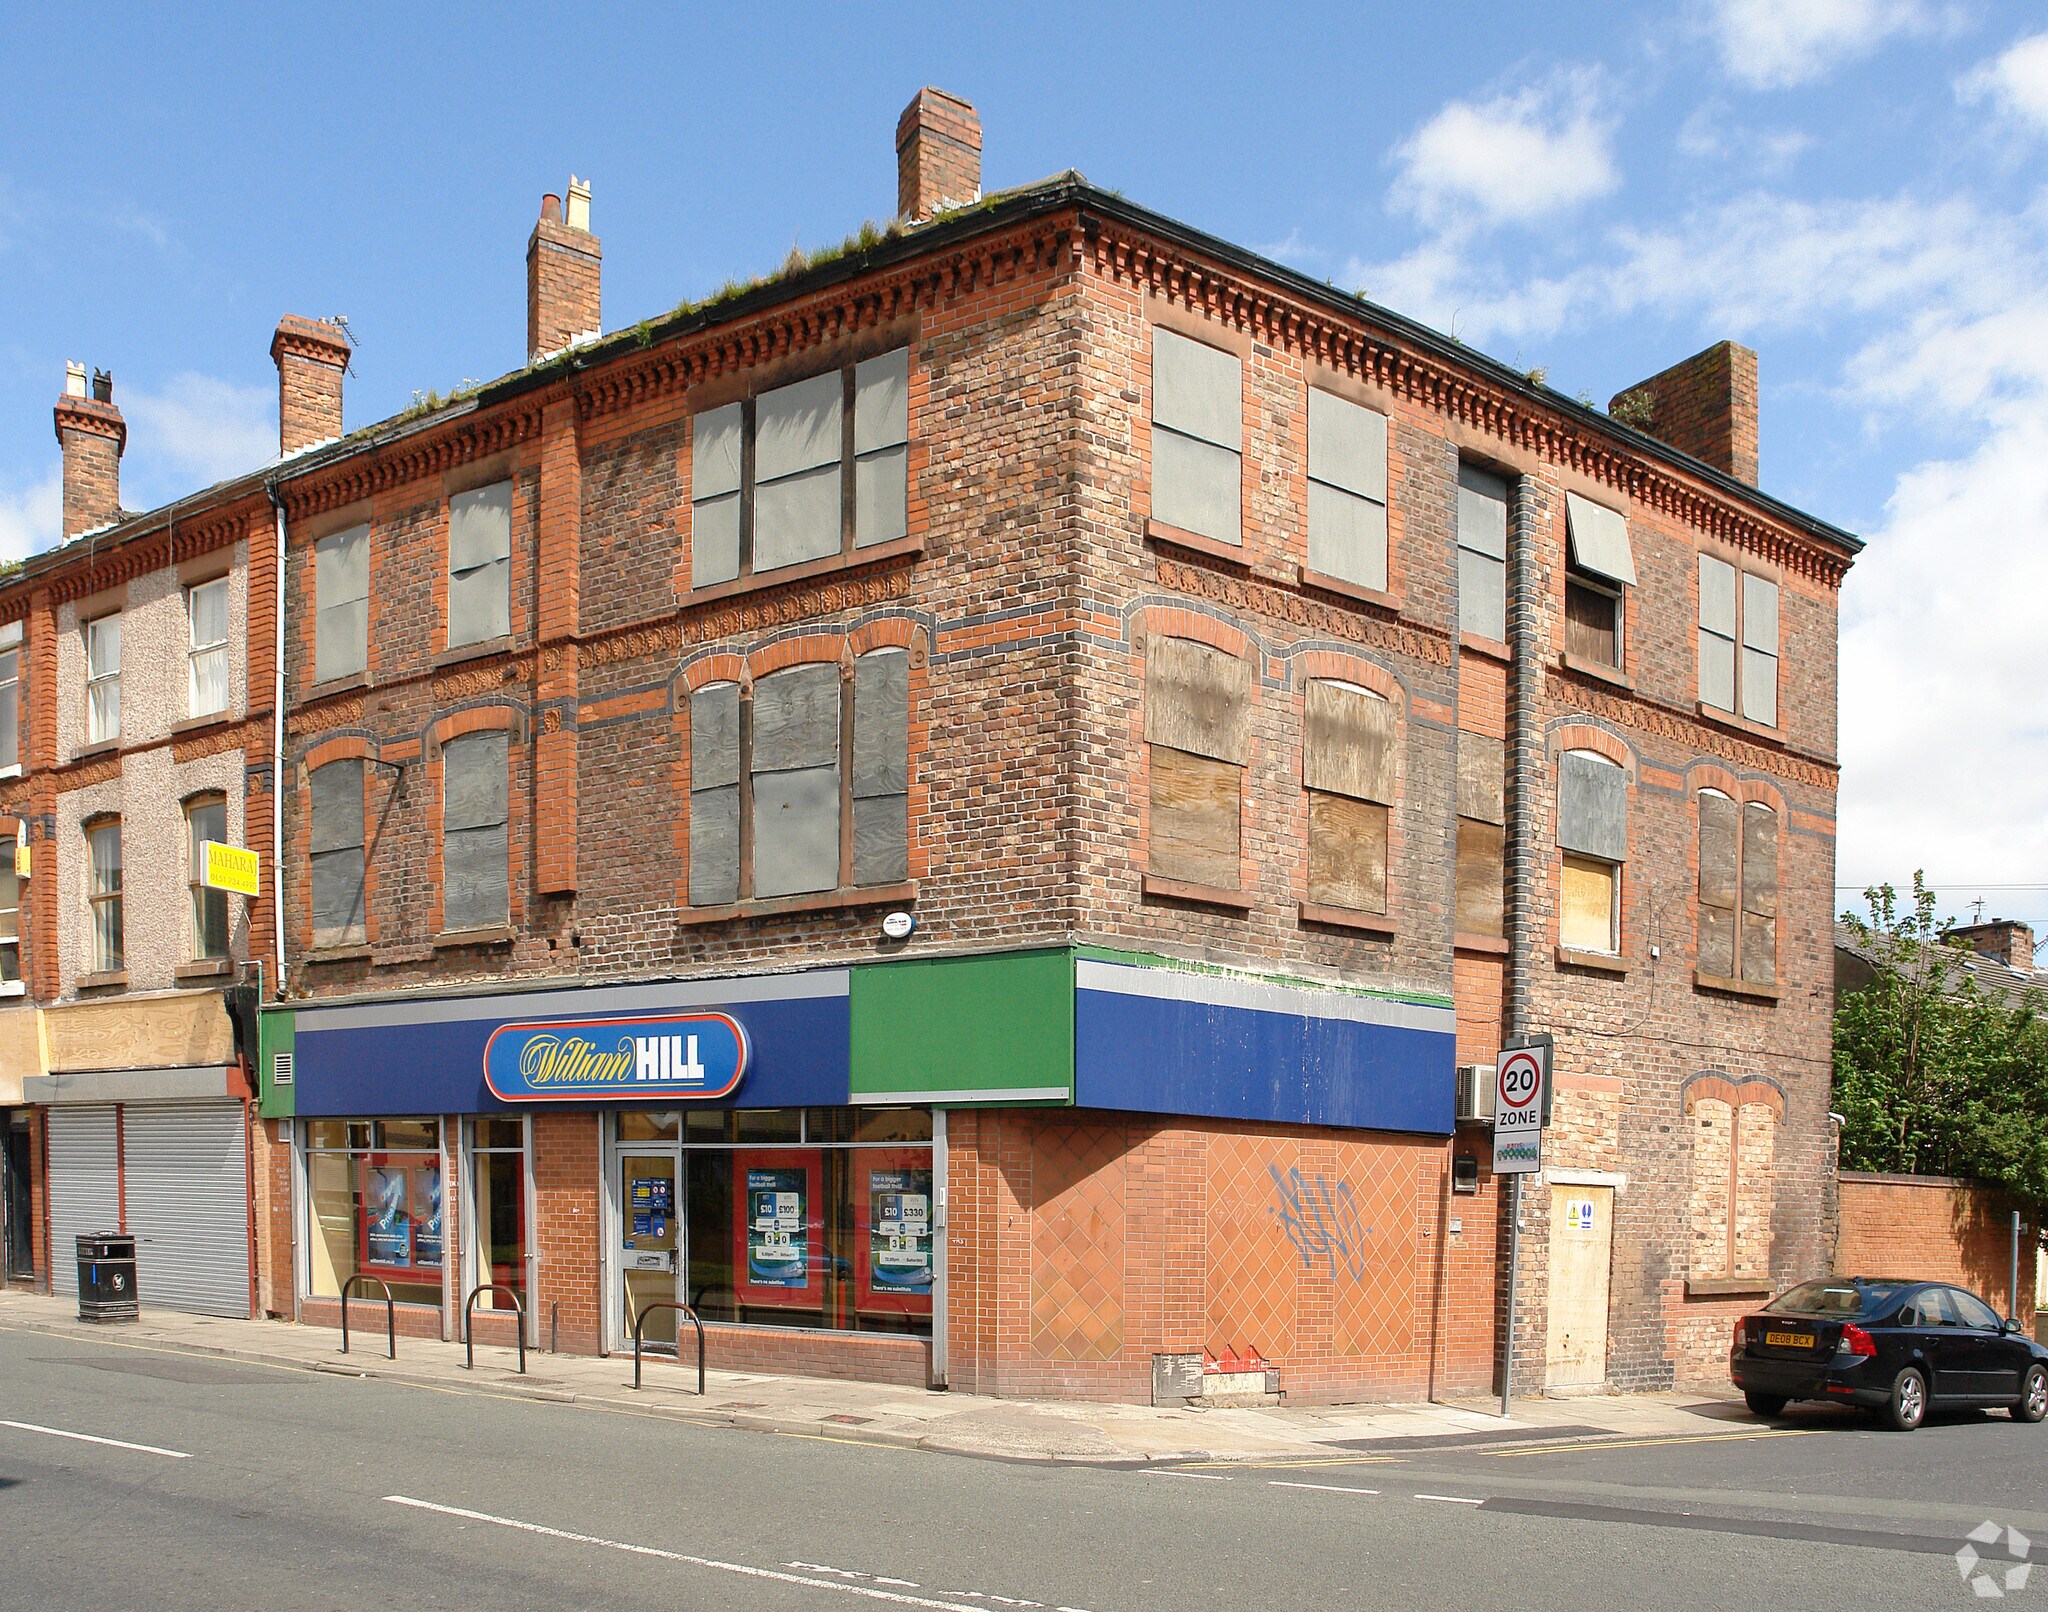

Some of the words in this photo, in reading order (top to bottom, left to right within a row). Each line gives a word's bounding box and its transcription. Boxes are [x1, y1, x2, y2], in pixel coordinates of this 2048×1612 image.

[208, 848, 258, 877] MAHARAJ
[519, 1034, 636, 1086] William
[635, 1034, 705, 1081] HILL
[1506, 1068, 1534, 1093] 20
[1499, 1110, 1537, 1126] ZONE
[760, 1204, 773, 1214] £10
[884, 1207, 898, 1217] £10
[903, 1208, 924, 1217] £330
[379, 1207, 396, 1231] Price
[767, 1235, 772, 1244] 3
[782, 1235, 787, 1244] 0
[892, 1239, 897, 1248] 3
[1769, 1333, 1792, 1344] DE08
[1793, 1335, 1811, 1346] BCX
